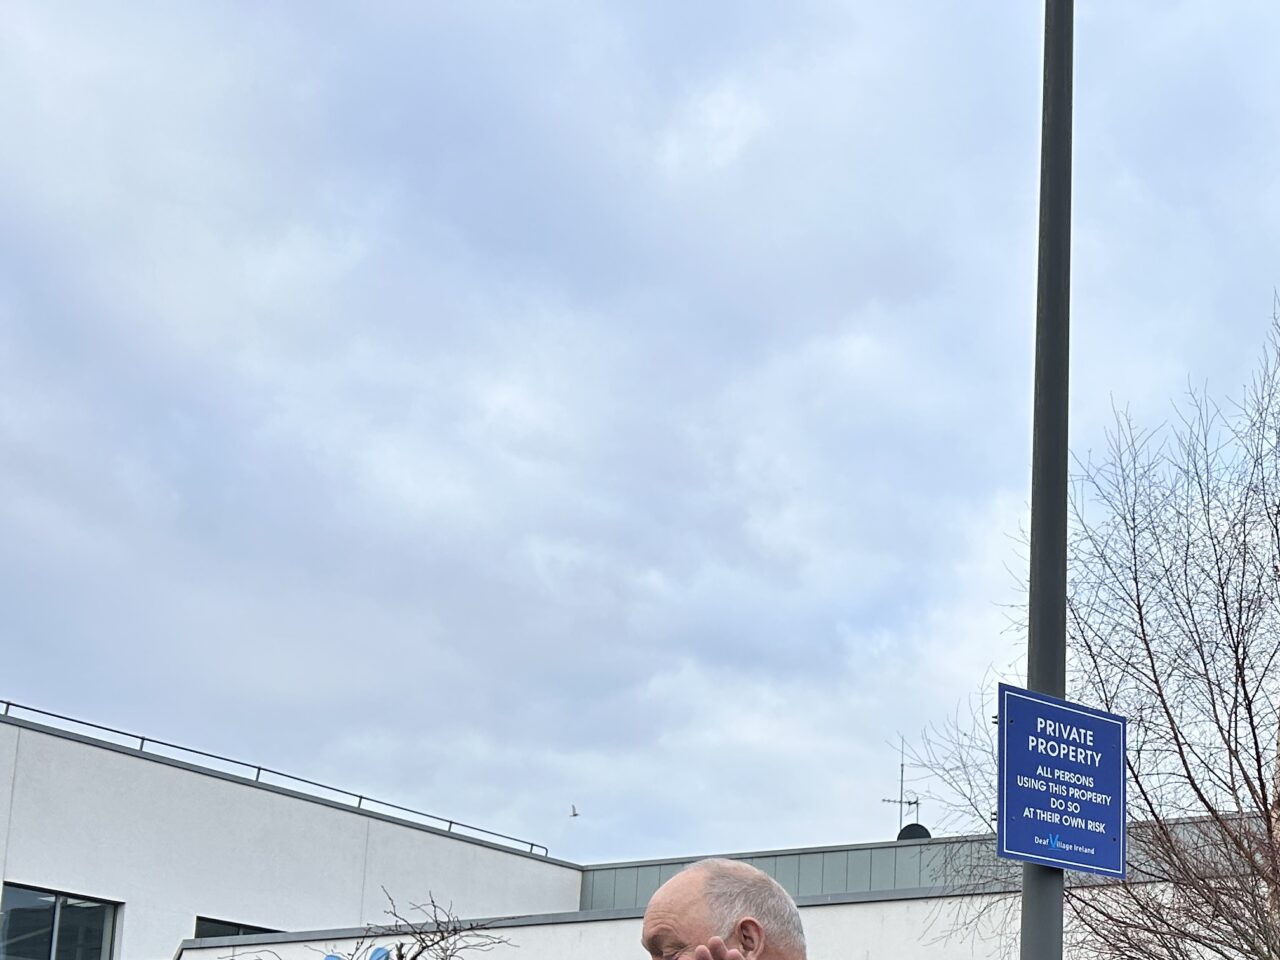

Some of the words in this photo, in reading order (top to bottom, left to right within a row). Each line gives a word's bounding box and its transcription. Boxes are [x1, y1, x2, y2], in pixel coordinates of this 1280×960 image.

[1037, 717, 1094, 746] PRIVATE
[1028, 735, 1102, 767] PROPERTY
[1036, 765, 1053, 779] ALL
[1054, 769, 1094, 788] PERSONS
[1017, 775, 1047, 791] USING
[1048, 782, 1067, 796] THIS
[1069, 787, 1112, 806] PROPERTY
[1050, 797, 1065, 810] DO
[1067, 801, 1081, 813] SO
[1023, 807, 1034, 819] AT
[1035, 809, 1060, 824] THEIR
[1062, 815, 1085, 829] OWN
[1087, 820, 1106, 834] RISK
[1034, 836, 1049, 845] Deaf
[1073, 844, 1095, 855] Ireland
